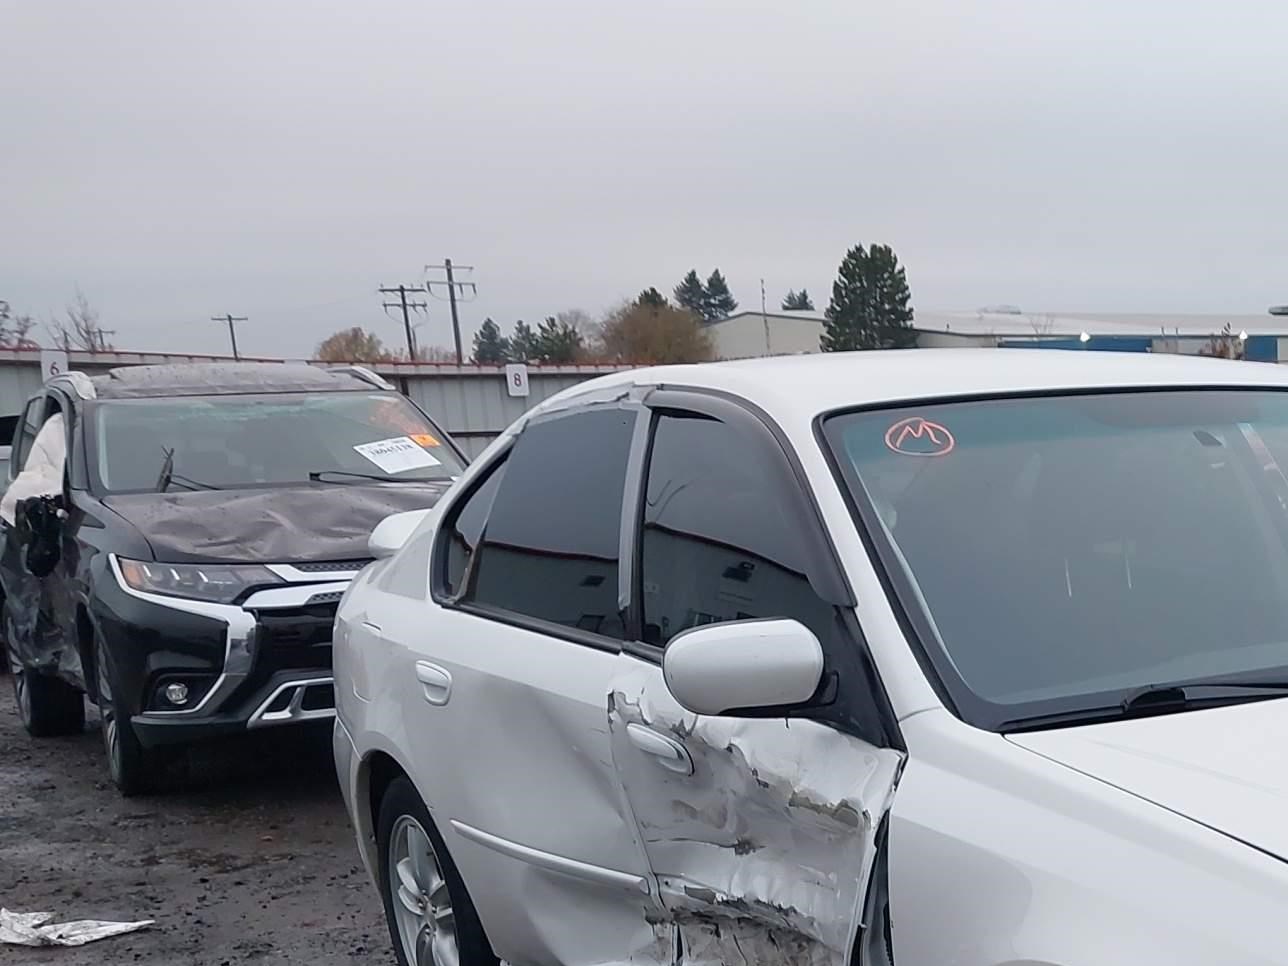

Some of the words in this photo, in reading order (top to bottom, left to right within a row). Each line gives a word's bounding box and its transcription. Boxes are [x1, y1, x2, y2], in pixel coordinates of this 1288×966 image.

[50, 361, 60, 376] 6
[513, 372, 522, 387] 8
[895, 421, 942, 449] M
